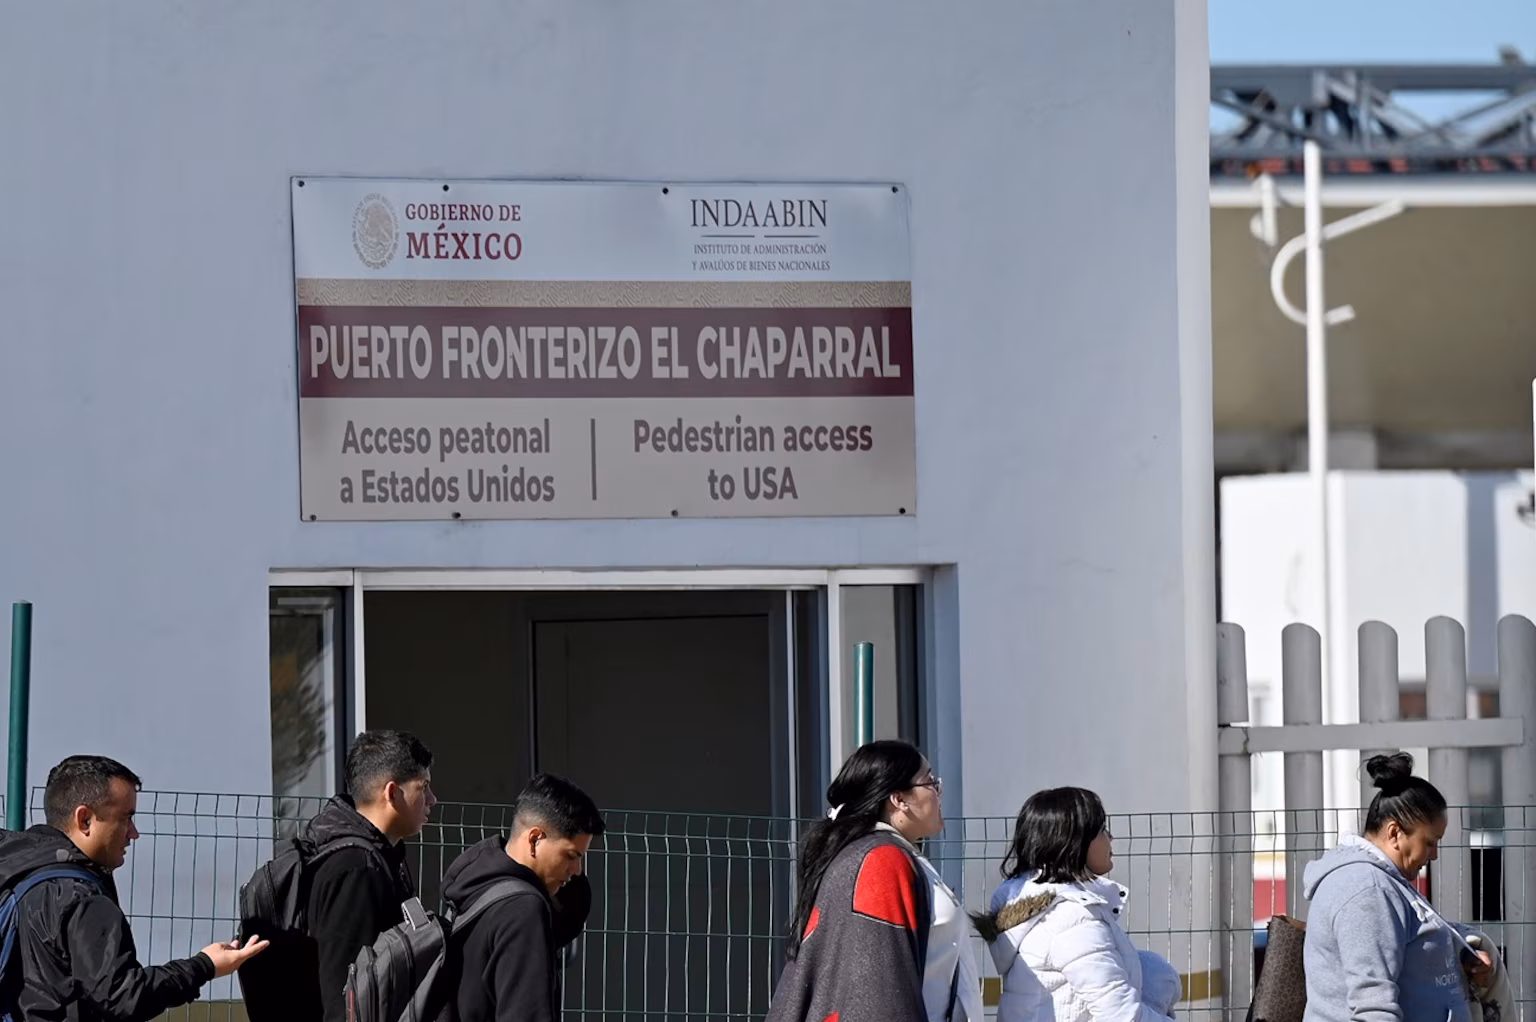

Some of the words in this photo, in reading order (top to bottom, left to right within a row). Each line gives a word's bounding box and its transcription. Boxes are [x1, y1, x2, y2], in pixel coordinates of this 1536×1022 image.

[405, 203, 494, 222] GOBIERNO
[499, 204, 522, 222] DE
[690, 199, 828, 227] INDAABIN
[405, 222, 523, 261] MÉXICO
[693, 244, 739, 255] INSTITUTO
[741, 244, 752, 255] DE
[753, 242, 827, 255] ADMINISTRACIÓN
[692, 261, 697, 271] Y
[699, 259, 735, 271] AVALÚOS
[736, 261, 747, 271] DE
[749, 261, 777, 271] BIENES
[778, 260, 831, 271] NACIONALES
[310, 325, 433, 380] PUERTO
[441, 325, 642, 380] FRONTERIZO
[651, 326, 689, 378] EL
[696, 325, 901, 380] CHAPARRAL
[341, 420, 432, 454] Acceso
[439, 418, 551, 463] peatonal
[634, 414, 775, 453] Pedestrian
[782, 424, 873, 452] access
[339, 476, 354, 504] a
[361, 467, 460, 503] Estados
[467, 464, 555, 503] Unidos
[707, 468, 736, 501] to
[743, 466, 799, 501] USA
